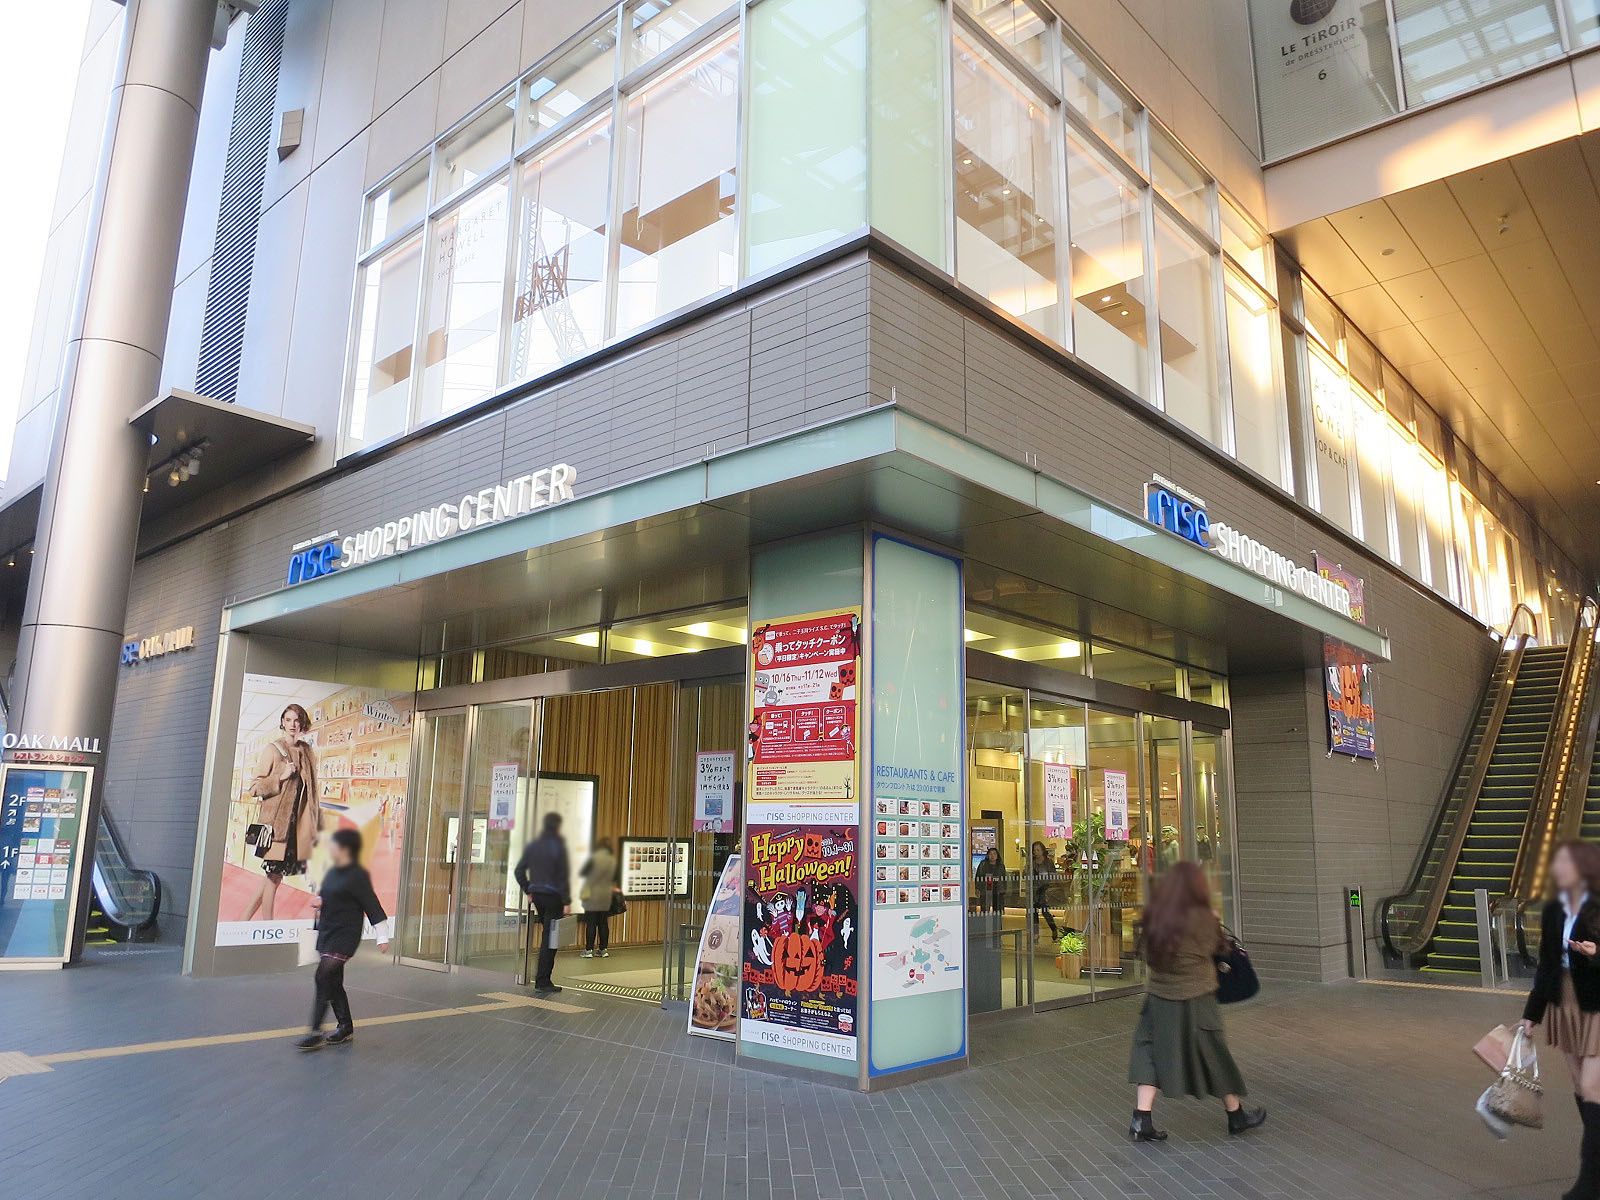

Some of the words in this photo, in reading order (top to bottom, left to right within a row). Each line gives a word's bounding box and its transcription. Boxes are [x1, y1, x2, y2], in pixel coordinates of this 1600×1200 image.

[1281, 44, 1296, 57] LE
[1318, 68, 1327, 80] 6
[288, 542, 337, 584] rise
[341, 502, 458, 568] SHOPPING
[459, 463, 577, 531] CENTER
[1150, 490, 1209, 548] rise
[1213, 522, 1298, 591] SHOPPING
[1298, 567, 1351, 619] CENTER
[365, 703, 399, 724] Winter
[2, 732, 46, 750] OAK
[49, 734, 102, 754] MALL
[876, 765, 928, 781] RESTAURANTS
[930, 770, 936, 781] &
[937, 771, 955, 783] CAFE
[8, 793, 27, 808] 2F
[766, 812, 785, 821] rise
[787, 812, 823, 821] SHOPPING
[824, 812, 854, 821] CENTER
[2, 845, 19, 859] 1F
[751, 832, 804, 865] Happy
[759, 855, 853, 892] Halloween!
[252, 928, 284, 940] rise
[761, 1031, 780, 1043] rise
[782, 1035, 820, 1050] SHOPPING
[821, 1042, 853, 1056] CENTER
